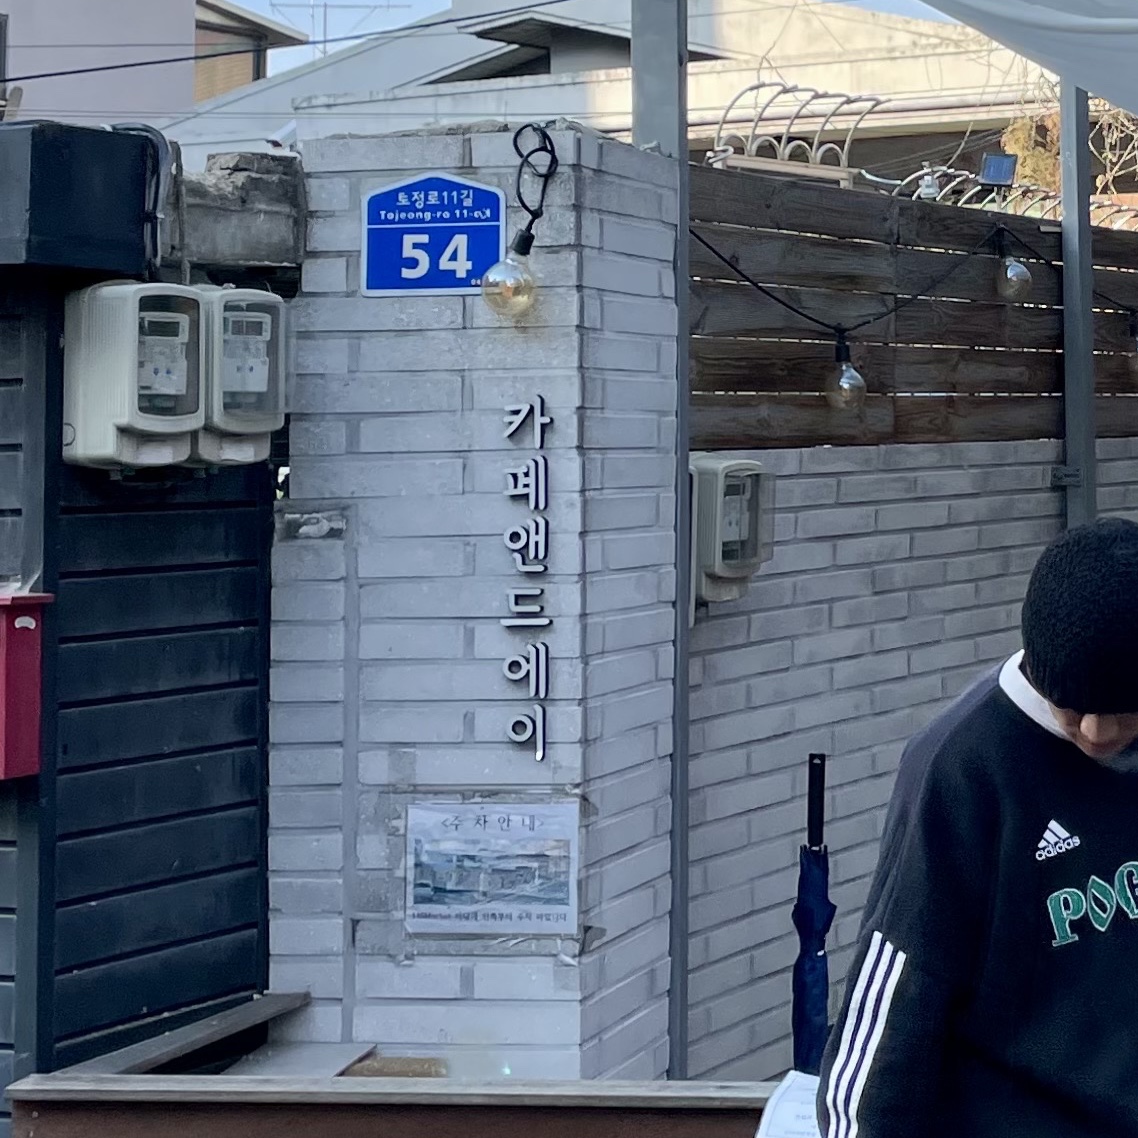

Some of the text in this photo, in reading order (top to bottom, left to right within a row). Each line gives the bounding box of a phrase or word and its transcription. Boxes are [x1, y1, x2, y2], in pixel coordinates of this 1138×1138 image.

[396, 189, 474, 209] 토정로11길
[379, 210, 451, 222] Tojeong-ro
[401, 234, 473, 279] 54
[500, 394, 552, 761] 카페앤드에이
[1035, 834, 1081, 861] adidas
